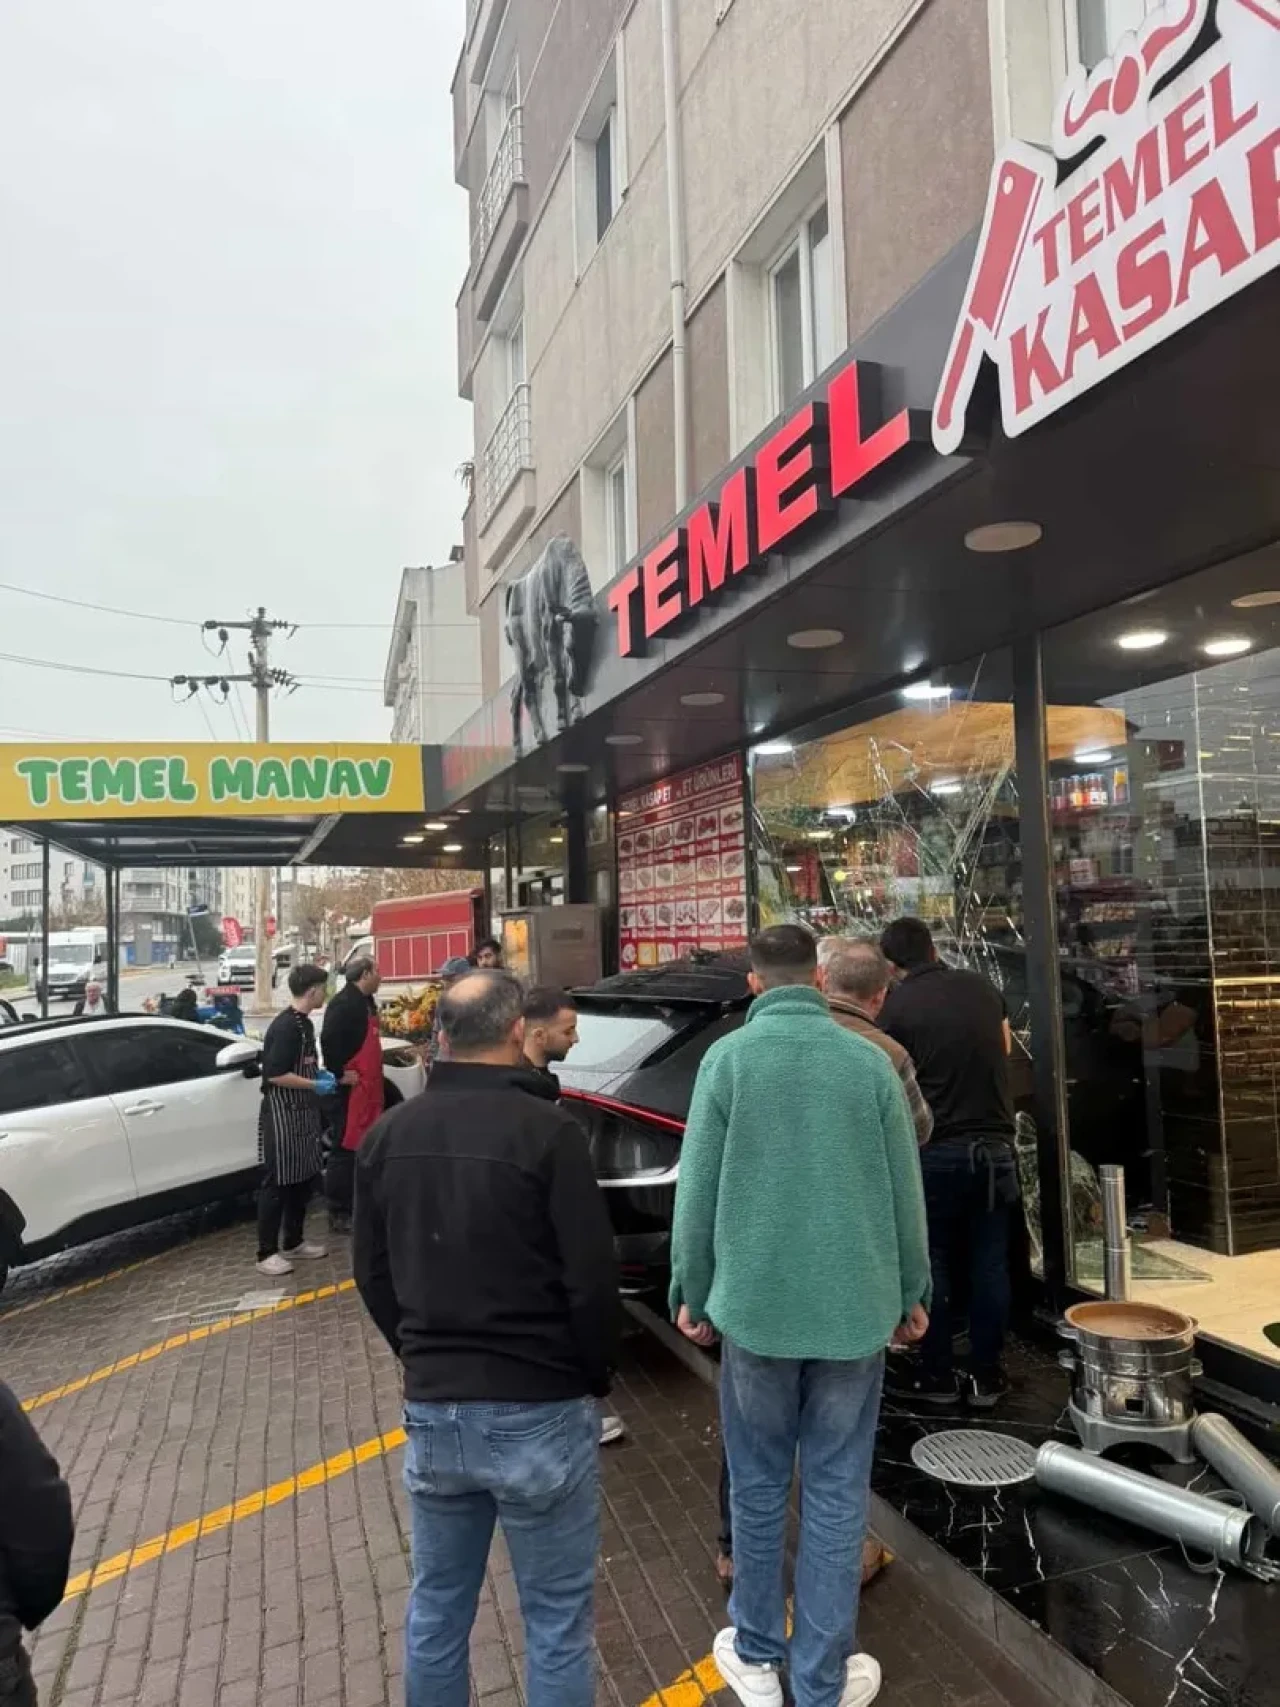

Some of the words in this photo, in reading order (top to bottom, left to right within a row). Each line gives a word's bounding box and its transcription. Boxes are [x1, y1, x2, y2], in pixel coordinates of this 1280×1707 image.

[1033, 63, 1258, 286] TEMEL
[607, 359, 910, 657] TEMEL
[16, 757, 198, 805] TEMEL
[208, 756, 393, 802] MANAV
